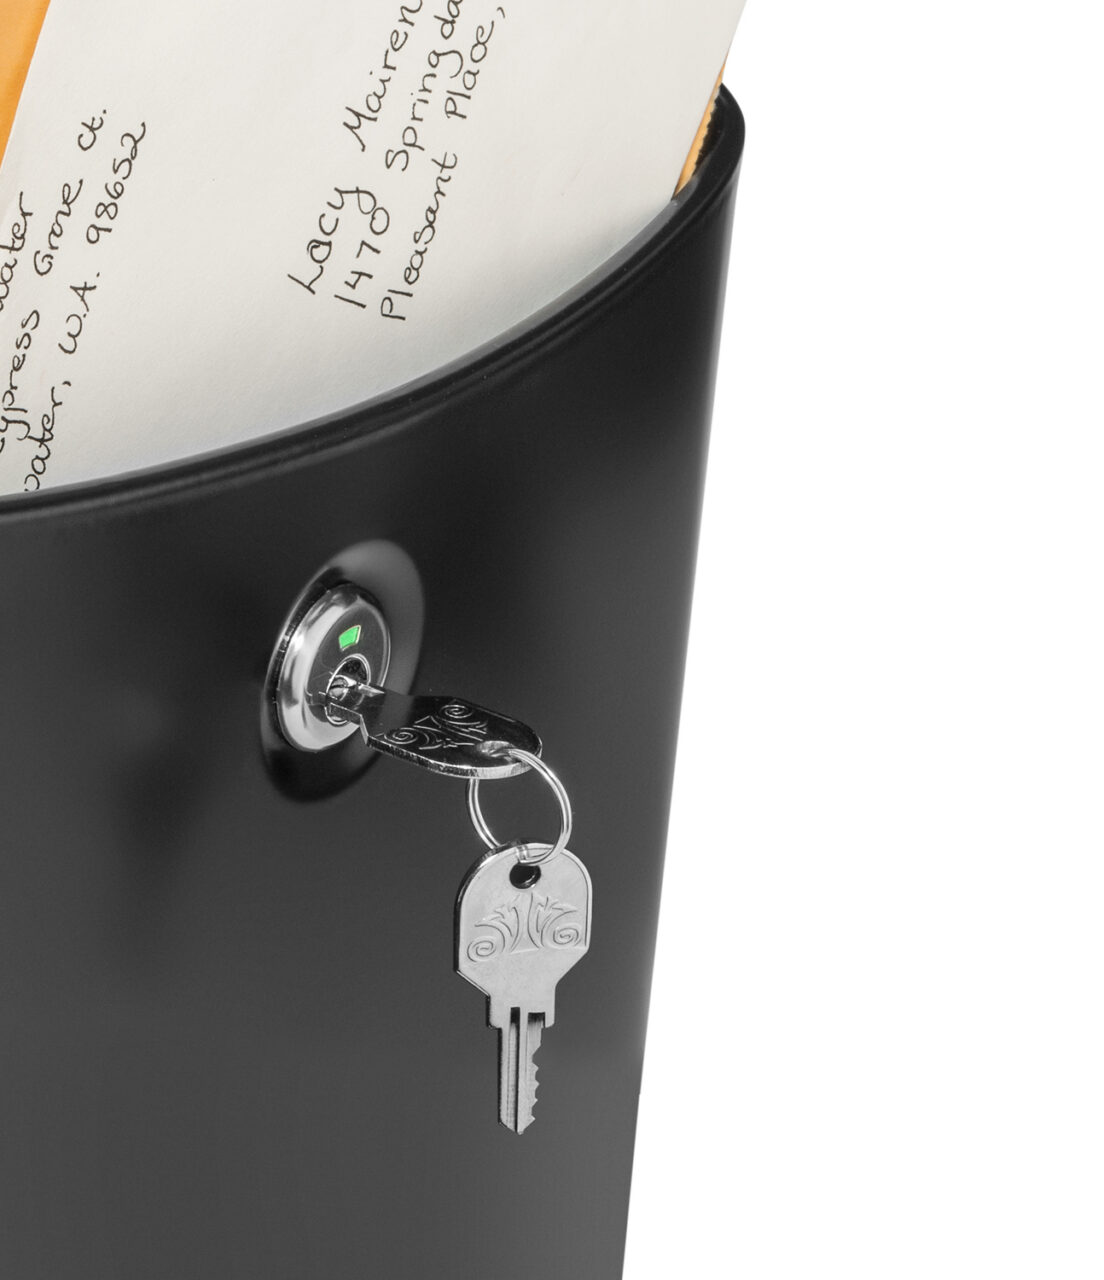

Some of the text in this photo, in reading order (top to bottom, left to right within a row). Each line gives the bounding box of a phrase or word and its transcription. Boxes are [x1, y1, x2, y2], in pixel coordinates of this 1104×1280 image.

[86, 122, 146, 244] 98652
[381, 152, 457, 320] Pleasant
[446, 6, 506, 119] Place,
[34, 180, 83, 275] Grove
[287, 187, 377, 294] Lacy
[334, 207, 389, 308] 1470
